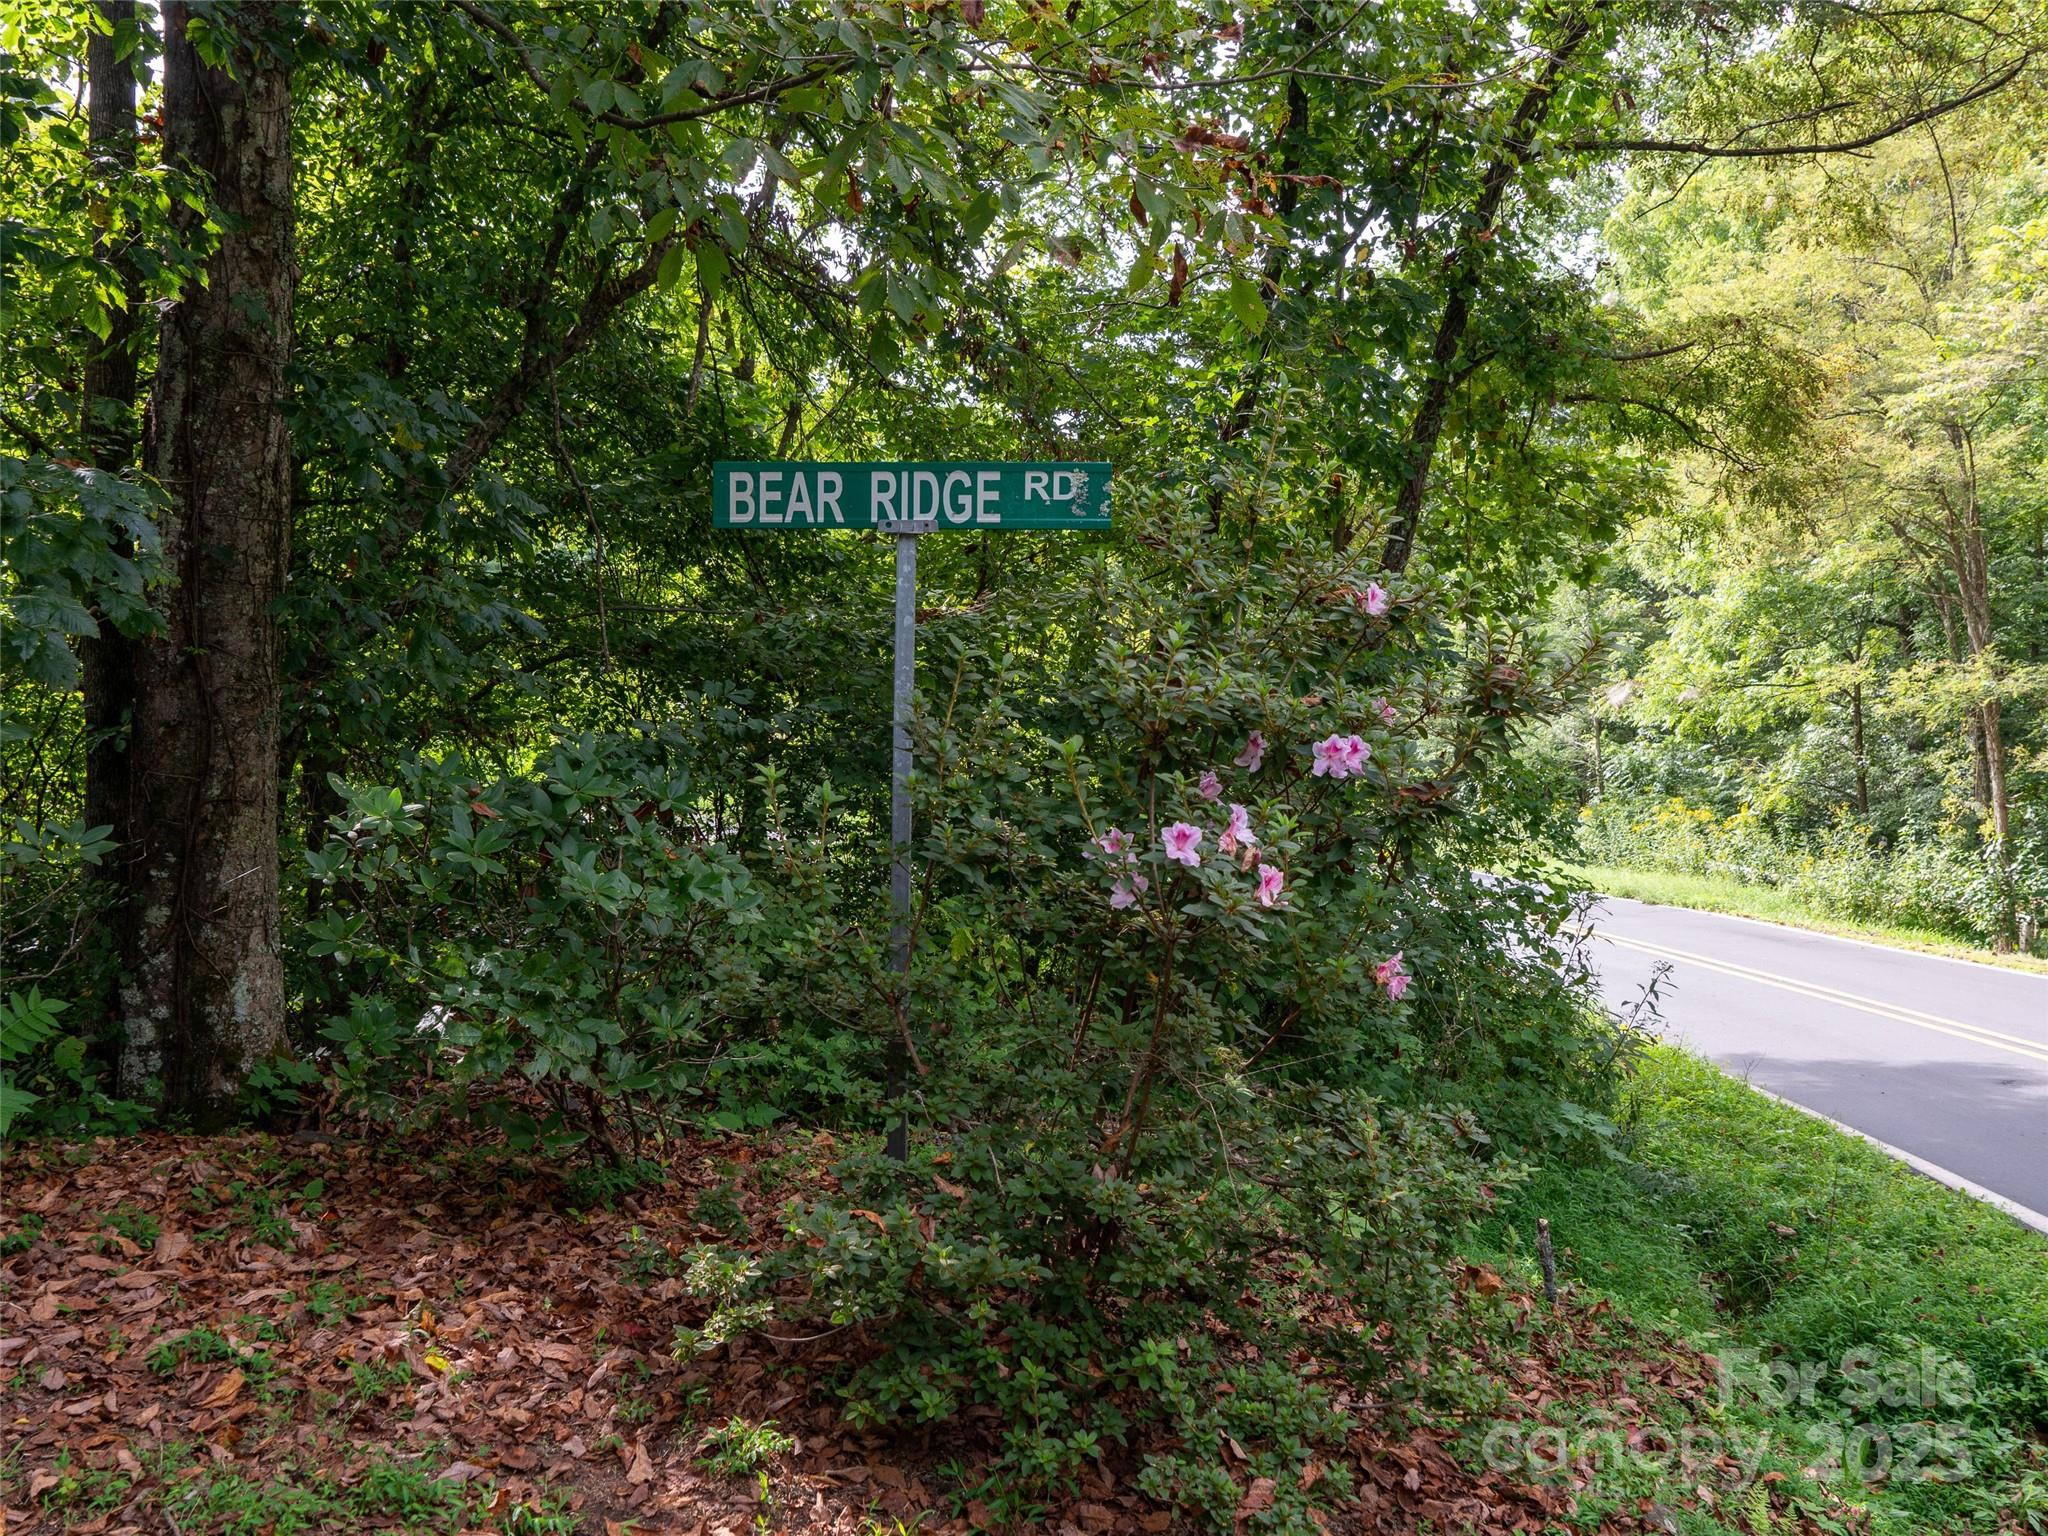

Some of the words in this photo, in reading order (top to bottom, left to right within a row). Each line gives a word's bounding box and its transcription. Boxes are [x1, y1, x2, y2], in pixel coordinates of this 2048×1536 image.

[728, 470, 845, 524] BEAR
[870, 470, 1001, 524] RIDGE
[1024, 470, 1078, 501] RD
